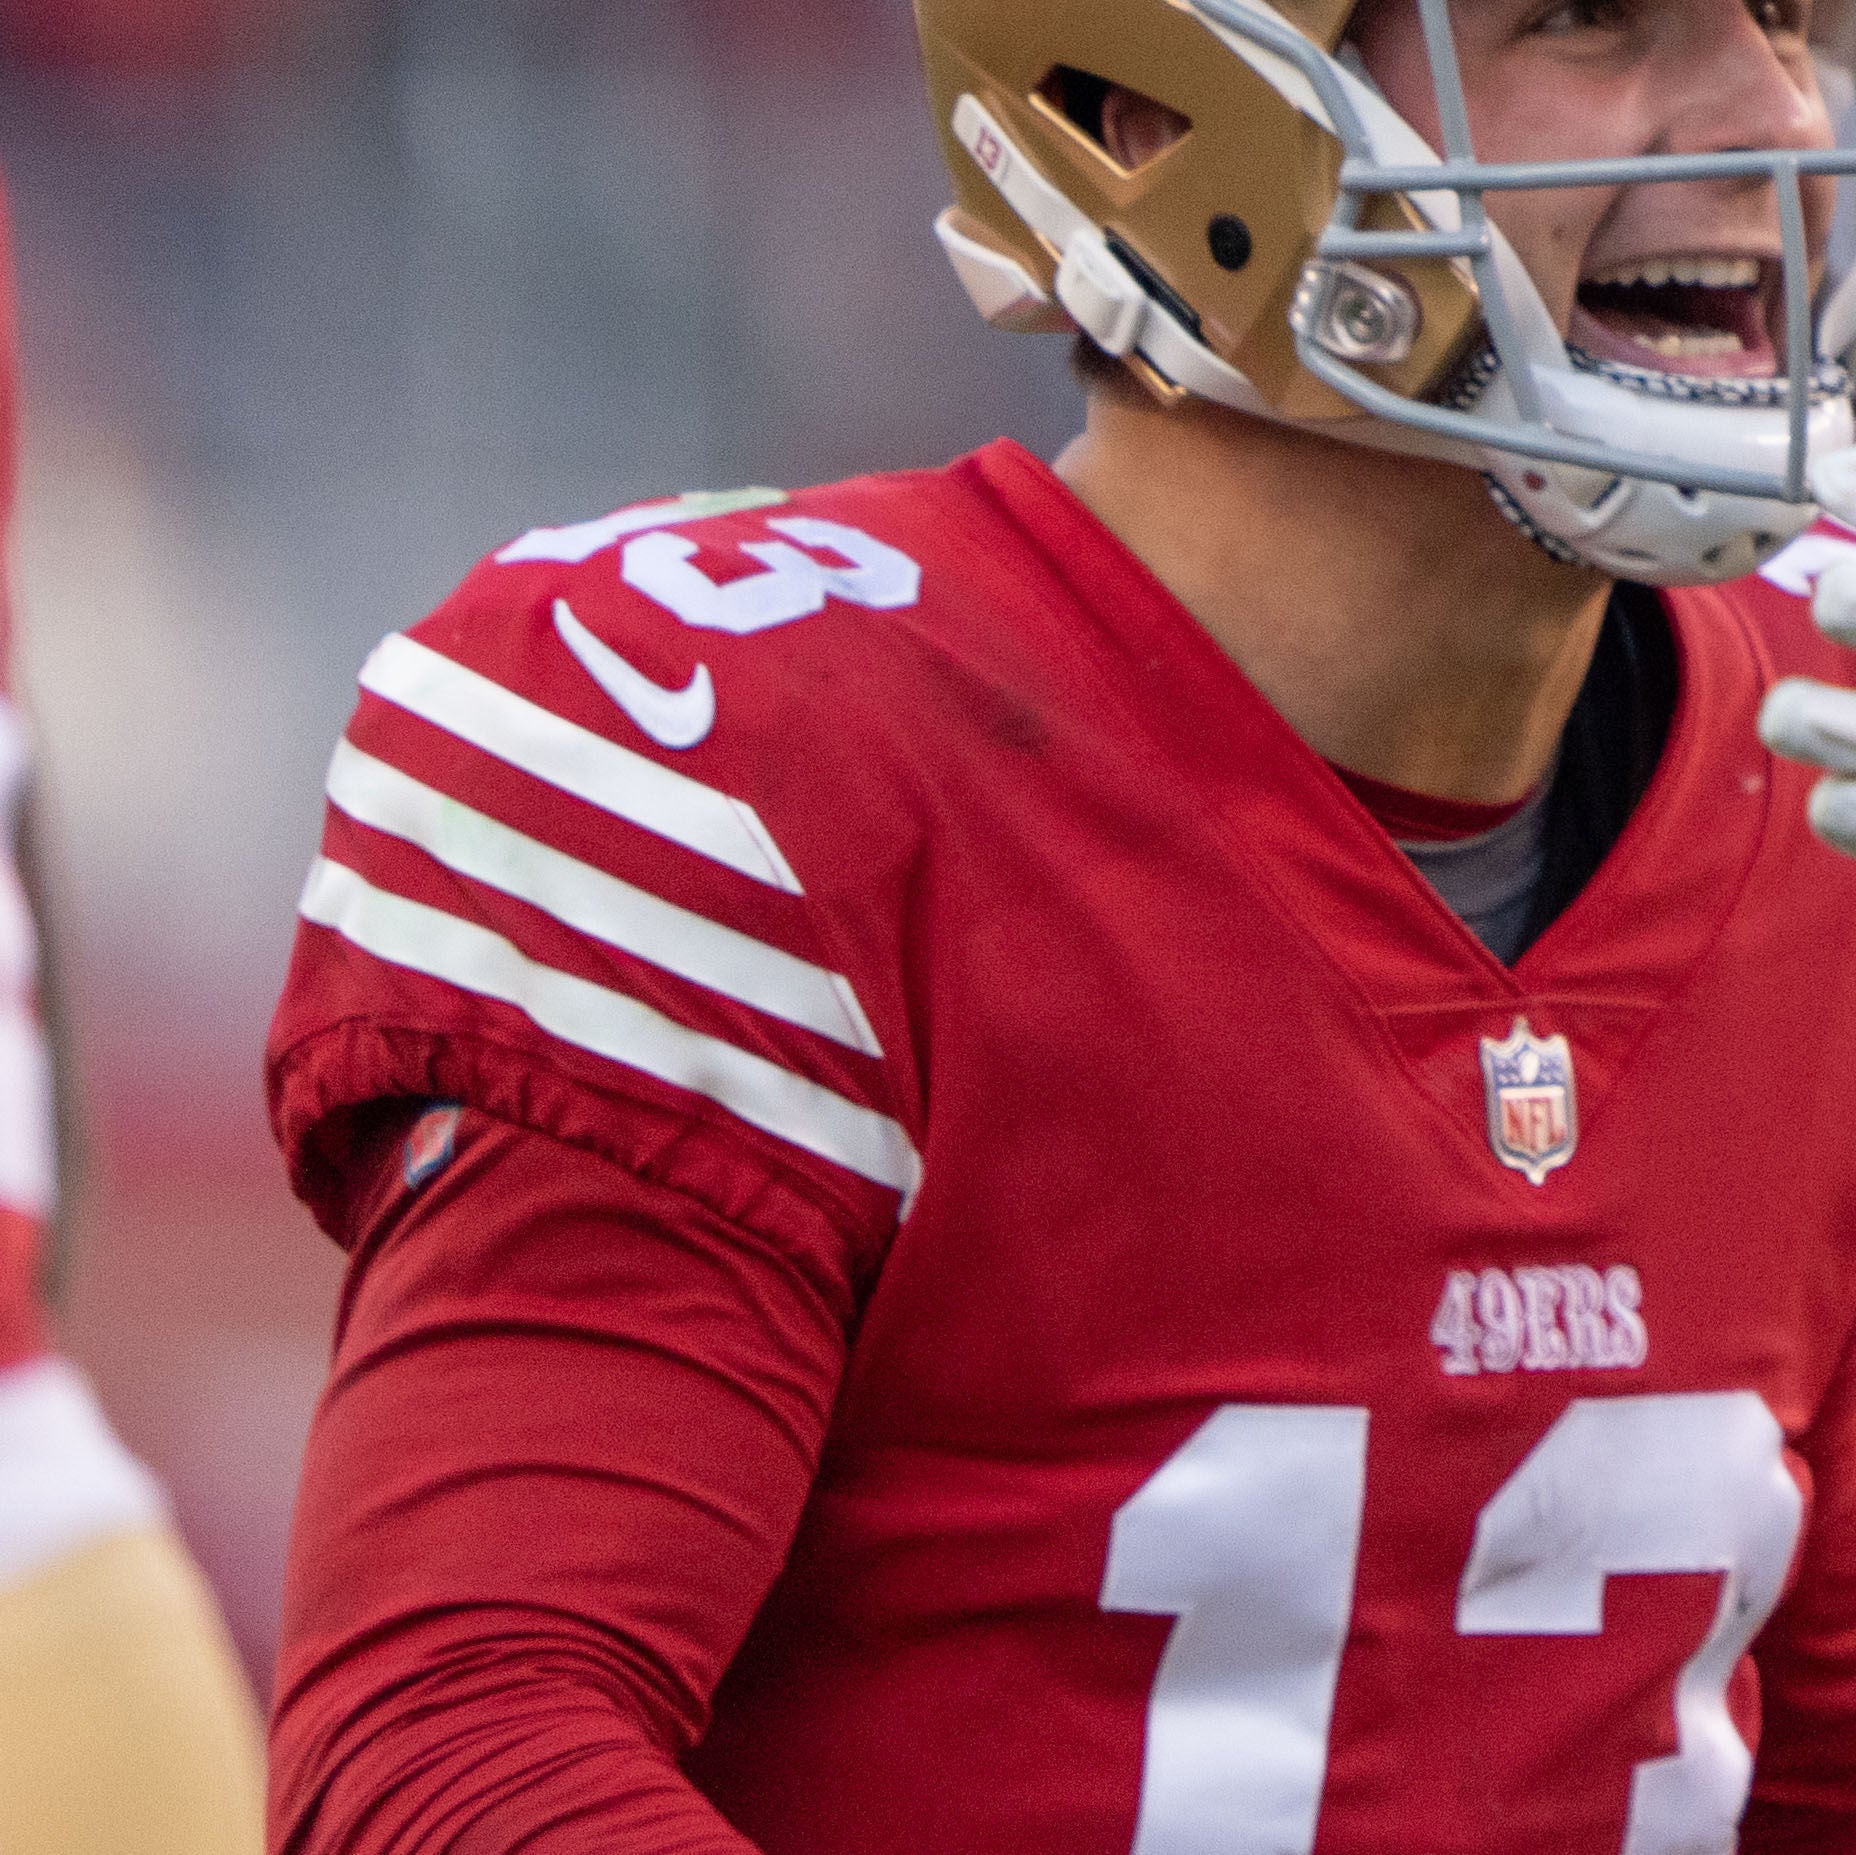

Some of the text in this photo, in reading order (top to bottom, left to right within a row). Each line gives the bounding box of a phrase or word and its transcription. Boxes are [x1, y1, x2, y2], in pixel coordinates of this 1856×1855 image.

[496, 486, 922, 635] 13
[1502, 1095, 1566, 1149] NFL
[1430, 1263, 1649, 1376] 49ERS
